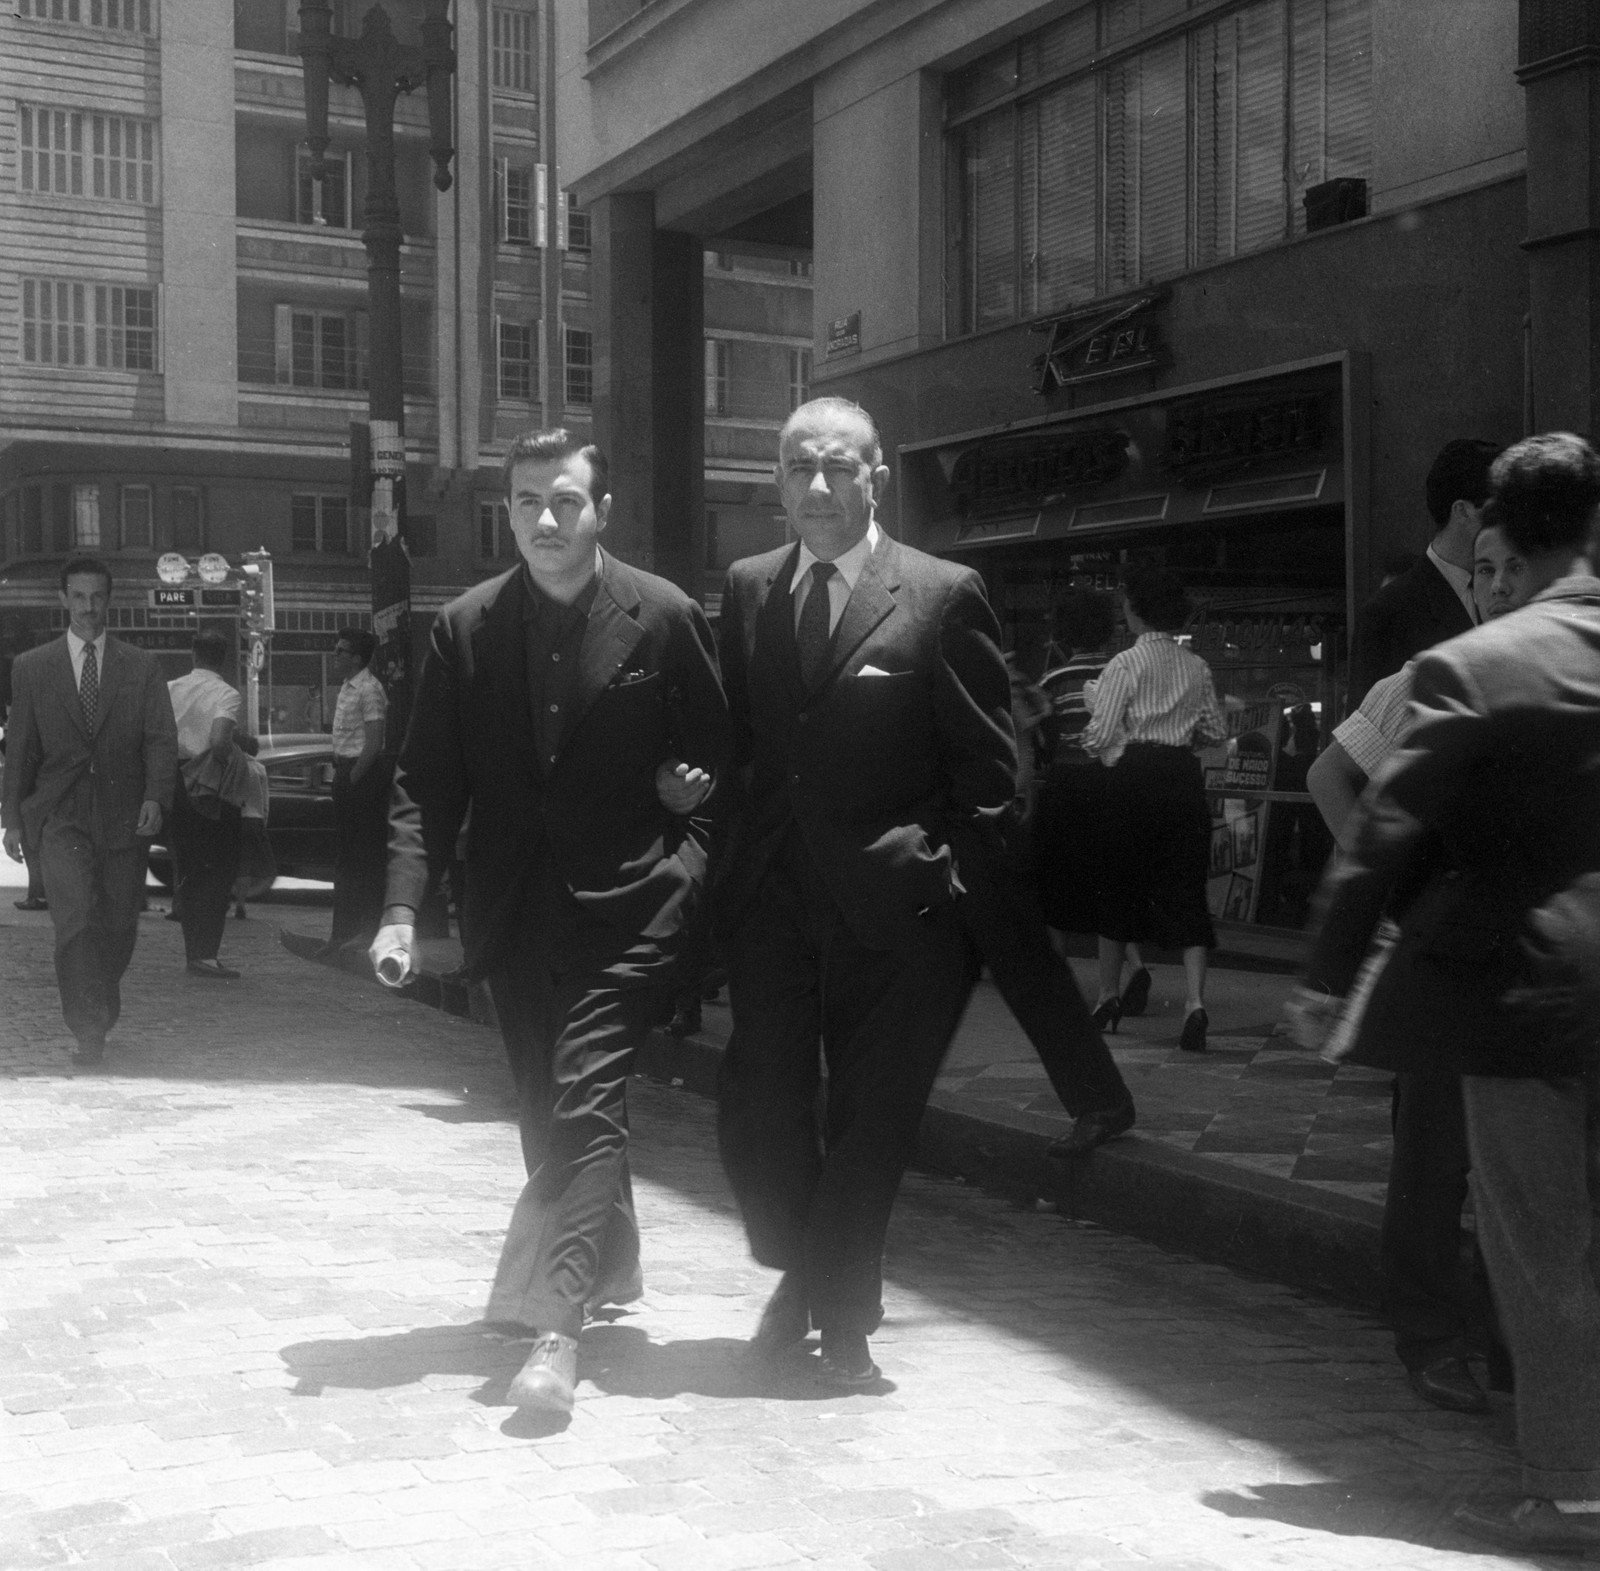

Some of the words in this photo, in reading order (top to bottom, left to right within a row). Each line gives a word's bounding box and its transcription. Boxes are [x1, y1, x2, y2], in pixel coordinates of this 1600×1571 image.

[159, 591, 186, 603] PARE
[1228, 757, 1241, 770] DE
[1225, 771, 1268, 786] SUCESSO
